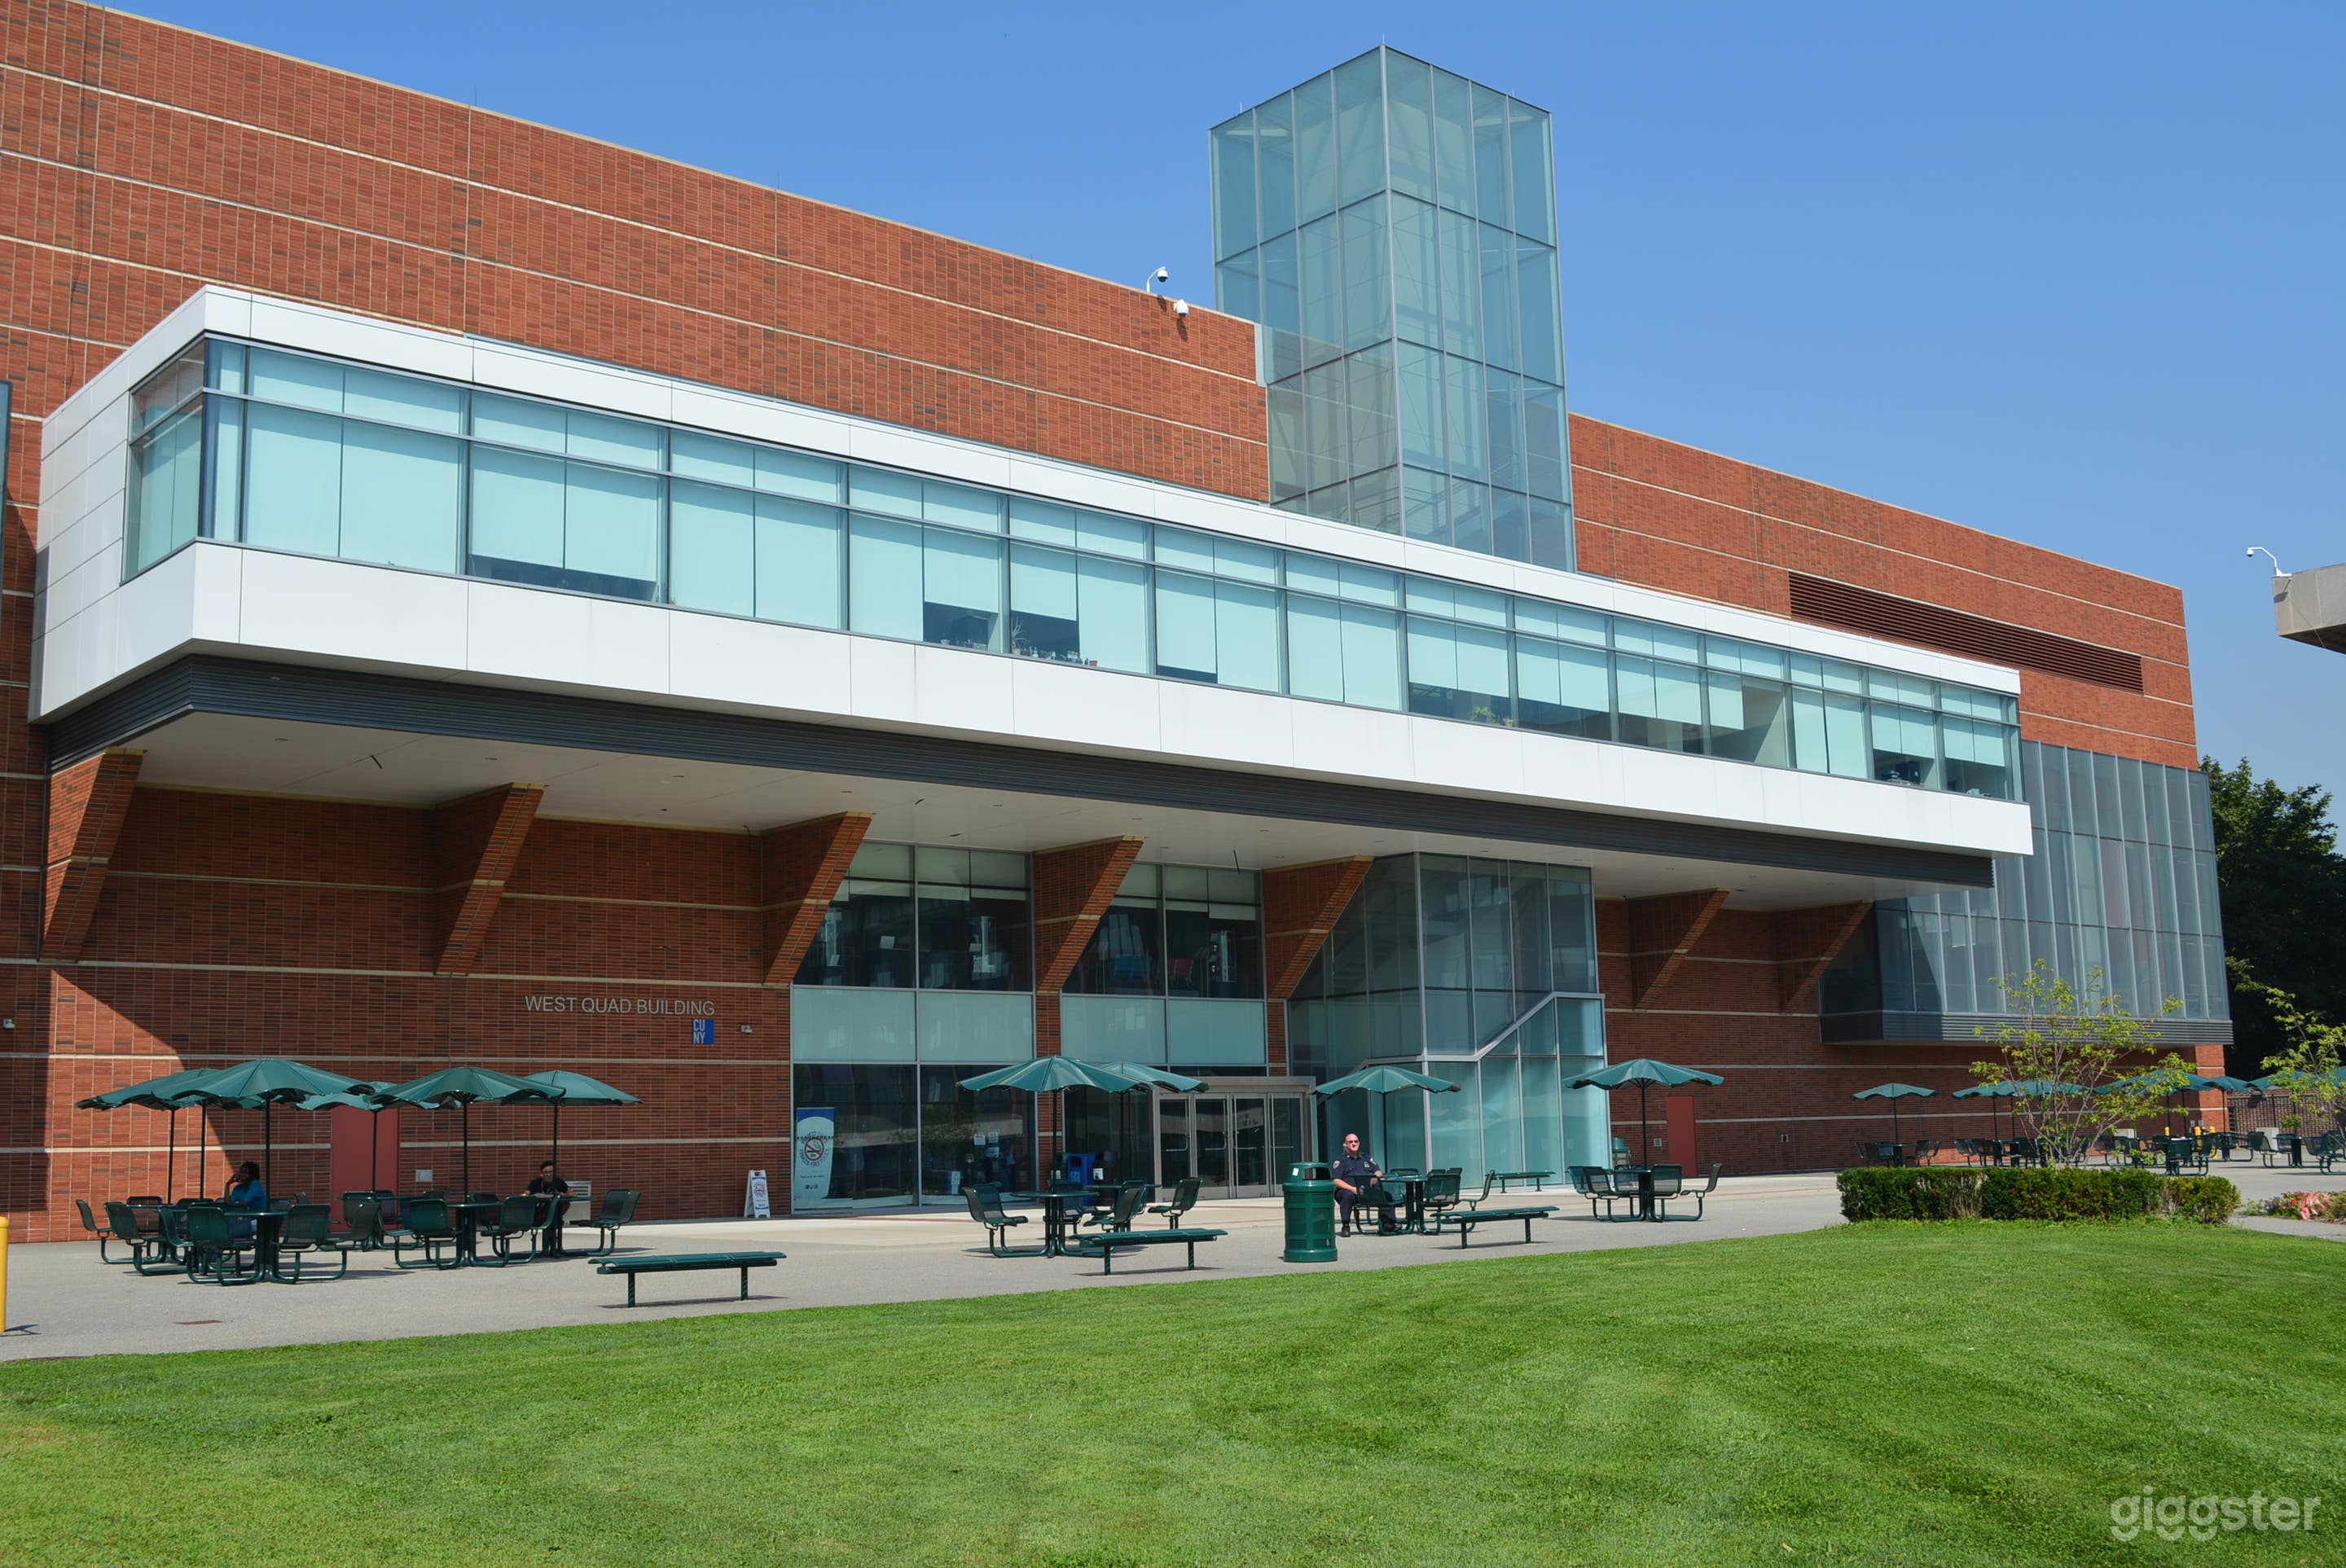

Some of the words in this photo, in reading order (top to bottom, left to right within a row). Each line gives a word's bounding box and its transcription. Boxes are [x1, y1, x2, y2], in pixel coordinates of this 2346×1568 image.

[525, 996, 577, 1012] WEST
[582, 998, 631, 1012] QUAD
[637, 999, 715, 1016] BUILDING
[693, 1019, 705, 1030] CU
[693, 1032, 706, 1043] NY
